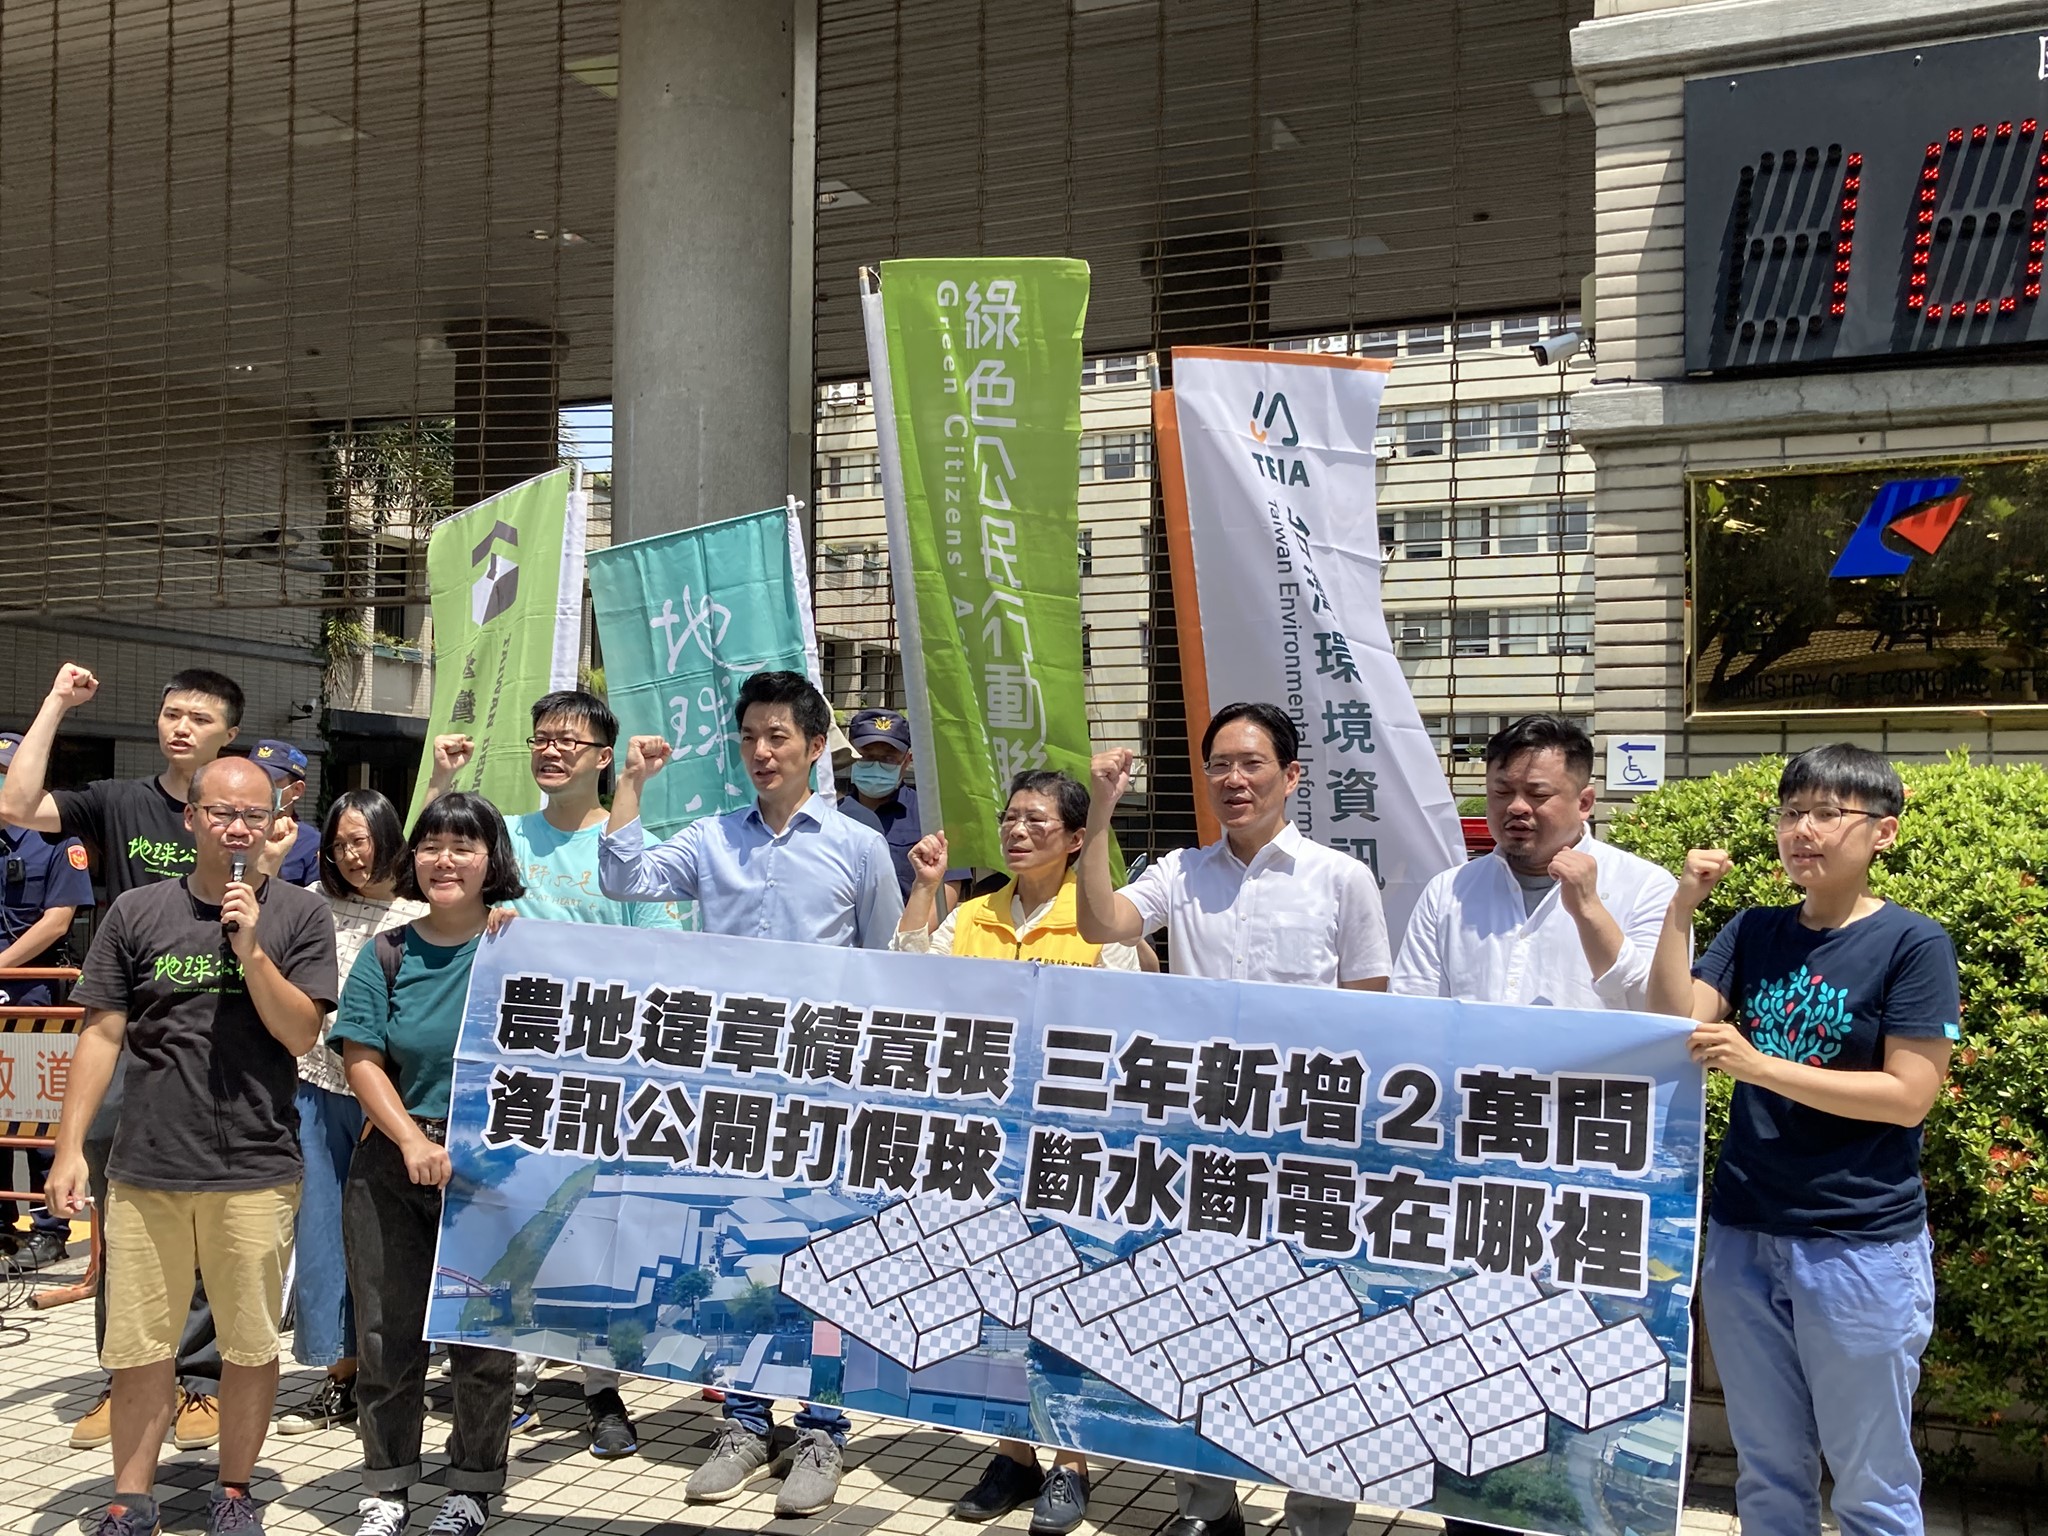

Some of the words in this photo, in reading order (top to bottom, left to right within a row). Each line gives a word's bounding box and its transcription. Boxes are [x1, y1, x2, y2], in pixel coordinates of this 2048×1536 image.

[936, 280, 960, 394] Green
[944, 413, 971, 577] Citizens'
[1251, 451, 1310, 487] TEIA
[1267, 500, 1293, 575] Taiwan
[1828, 671, 1857, 695] OF
[498, 976, 1014, 1102] 農地違章續囂張
[485, 1069, 1002, 1201] 資訊公開打假球
[1025, 1131, 1646, 1294] 斷水斷電在哪裡
